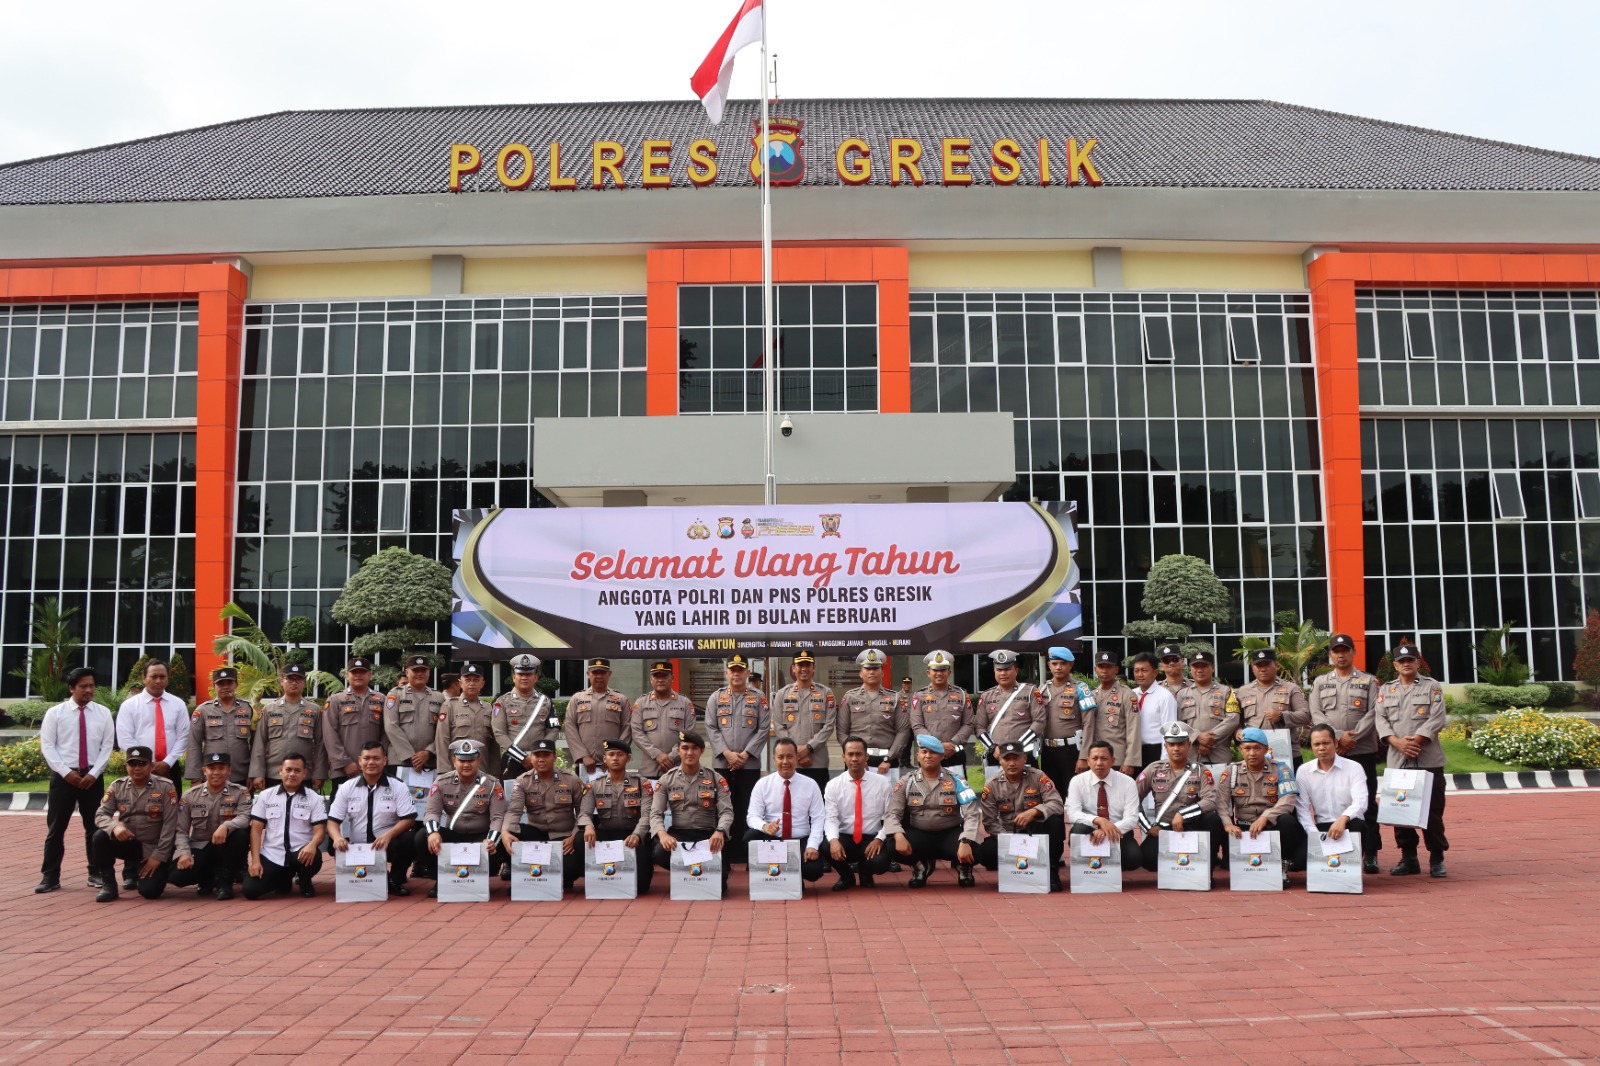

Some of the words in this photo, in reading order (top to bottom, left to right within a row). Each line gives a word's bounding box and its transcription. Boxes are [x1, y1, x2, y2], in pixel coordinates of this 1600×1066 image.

[778, 119, 798, 127] TIMUR
[449, 138, 719, 191] POLRES
[836, 137, 1102, 187] GRESIK
[570, 549, 725, 581] Selamat
[734, 546, 842, 588] Ulang
[844, 544, 961, 576] Tahun
[598, 589, 672, 606] ANGGOTA
[677, 588, 725, 605] POLRI
[731, 588, 763, 605] DAN
[769, 587, 801, 604] PNS
[806, 586, 869, 603] POLRES
[874, 585, 932, 602] GRESIK
[635, 610, 676, 627] YANG
[682, 609, 730, 626] LAHIR
[736, 609, 752, 626] DI
[758, 608, 811, 625] BULAN
[816, 607, 897, 624] FEBRUARI
[620, 639, 658, 651] POLRES
[658, 639, 694, 651] GRESIK
[697, 638, 736, 650] SANTUN
